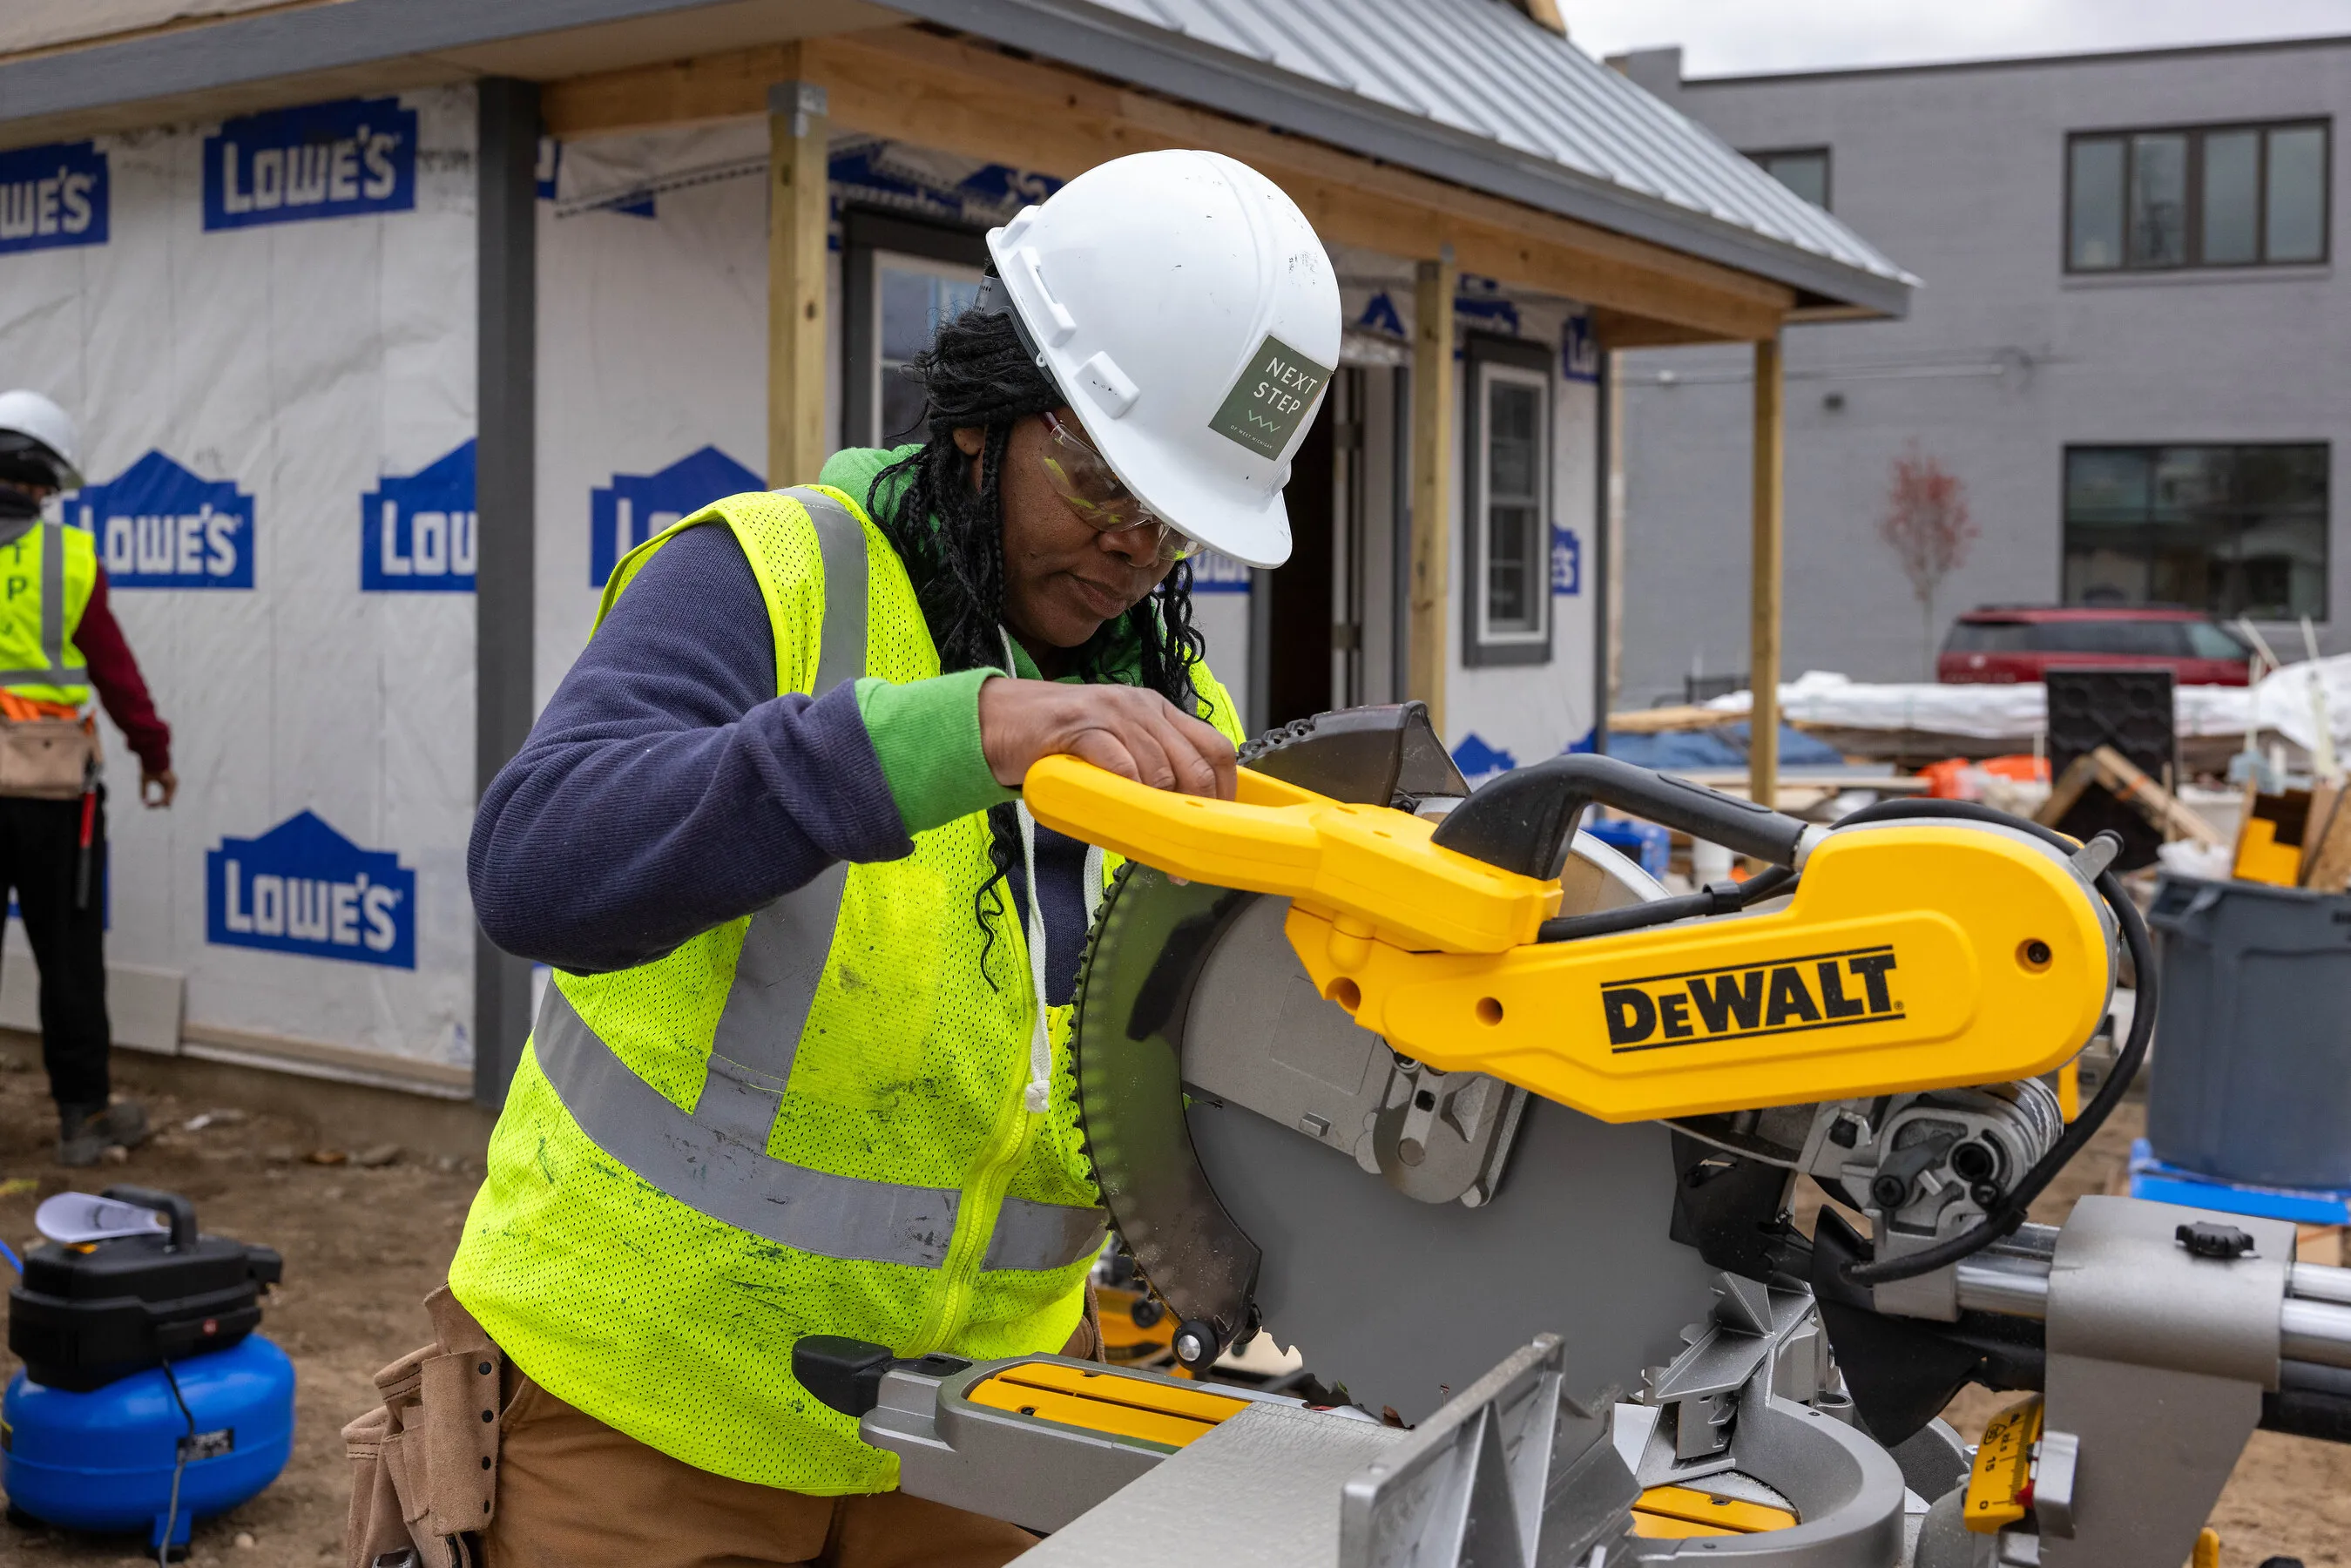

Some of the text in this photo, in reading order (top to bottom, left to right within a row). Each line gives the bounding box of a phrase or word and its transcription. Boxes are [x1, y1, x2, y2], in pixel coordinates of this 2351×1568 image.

[223, 125, 397, 214] LOWE'S
[1266, 357, 1318, 394] NEXT
[1253, 382, 1300, 414] STEP
[1239, 429, 1252, 438] WEST
[1252, 436, 1273, 449] MICHIGAN
[225, 859, 397, 952] LOWE'S
[1602, 953, 1897, 1045] DEWALT
[1985, 1456, 1996, 1472] 15
